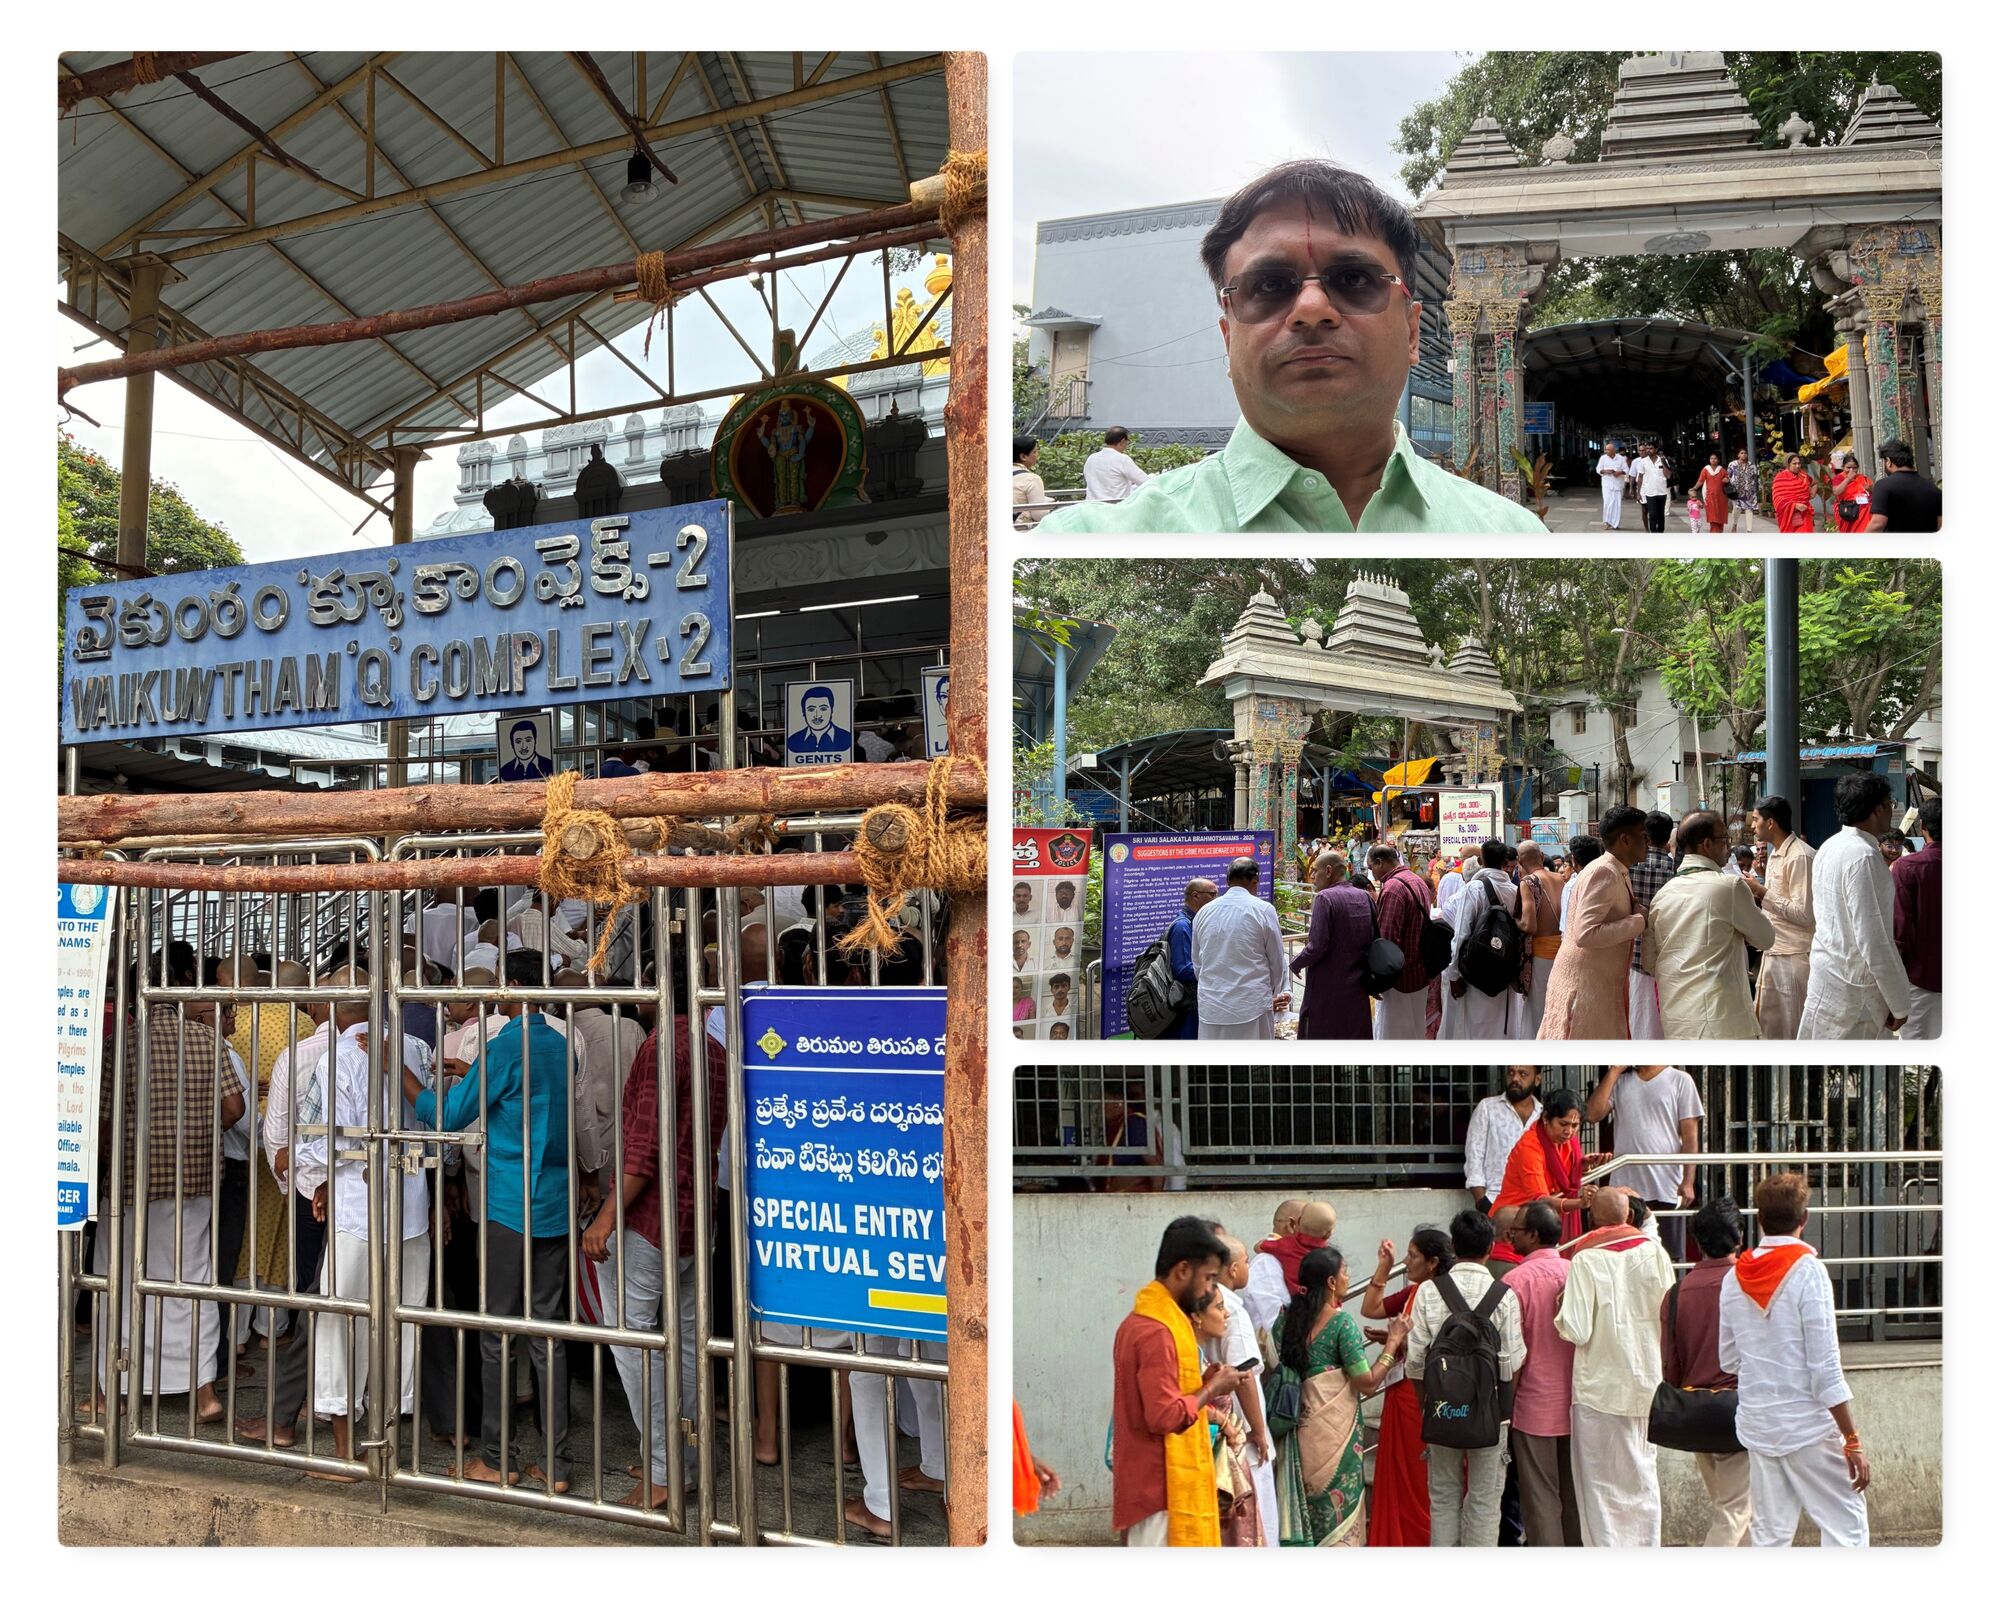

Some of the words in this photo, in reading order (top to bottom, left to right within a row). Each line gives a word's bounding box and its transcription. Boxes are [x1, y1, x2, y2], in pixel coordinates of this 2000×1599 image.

[795, 754, 843, 764] GENTS
[1458, 825, 1466, 833] Rs.
[1443, 836, 1461, 844] SPECIAL
[1462, 836, 1477, 844] ENTRY
[1137, 849, 1169, 857] SUGGESTIONS
[1175, 848, 1184, 856] THE
[1198, 847, 1213, 855] POLICE
[77, 922, 99, 932] THE
[78, 988, 90, 998] are
[70, 1007, 79, 1017] as
[84, 1008, 88, 1017] a
[69, 1024, 87, 1037] there
[58, 1042, 86, 1058] Pilgrims
[796, 1036, 863, 1054] తిరుమల
[867, 1037, 930, 1055] తిరుపతి
[73, 1082, 84, 1094] the
[67, 1101, 83, 1114] Lord
[756, 1093, 808, 1129] ప్రత్యేక
[812, 1096, 865, 1128] ప్రవేశ
[755, 1138, 795, 1170] సేవా
[857, 1148, 918, 1177] కలిగిన
[753, 1197, 847, 1234] SPECIAL
[854, 1204, 934, 1240] ENTRY
[755, 1239, 879, 1277] VIRTUAL
[1442, 1404, 1469, 1419] Knoll
